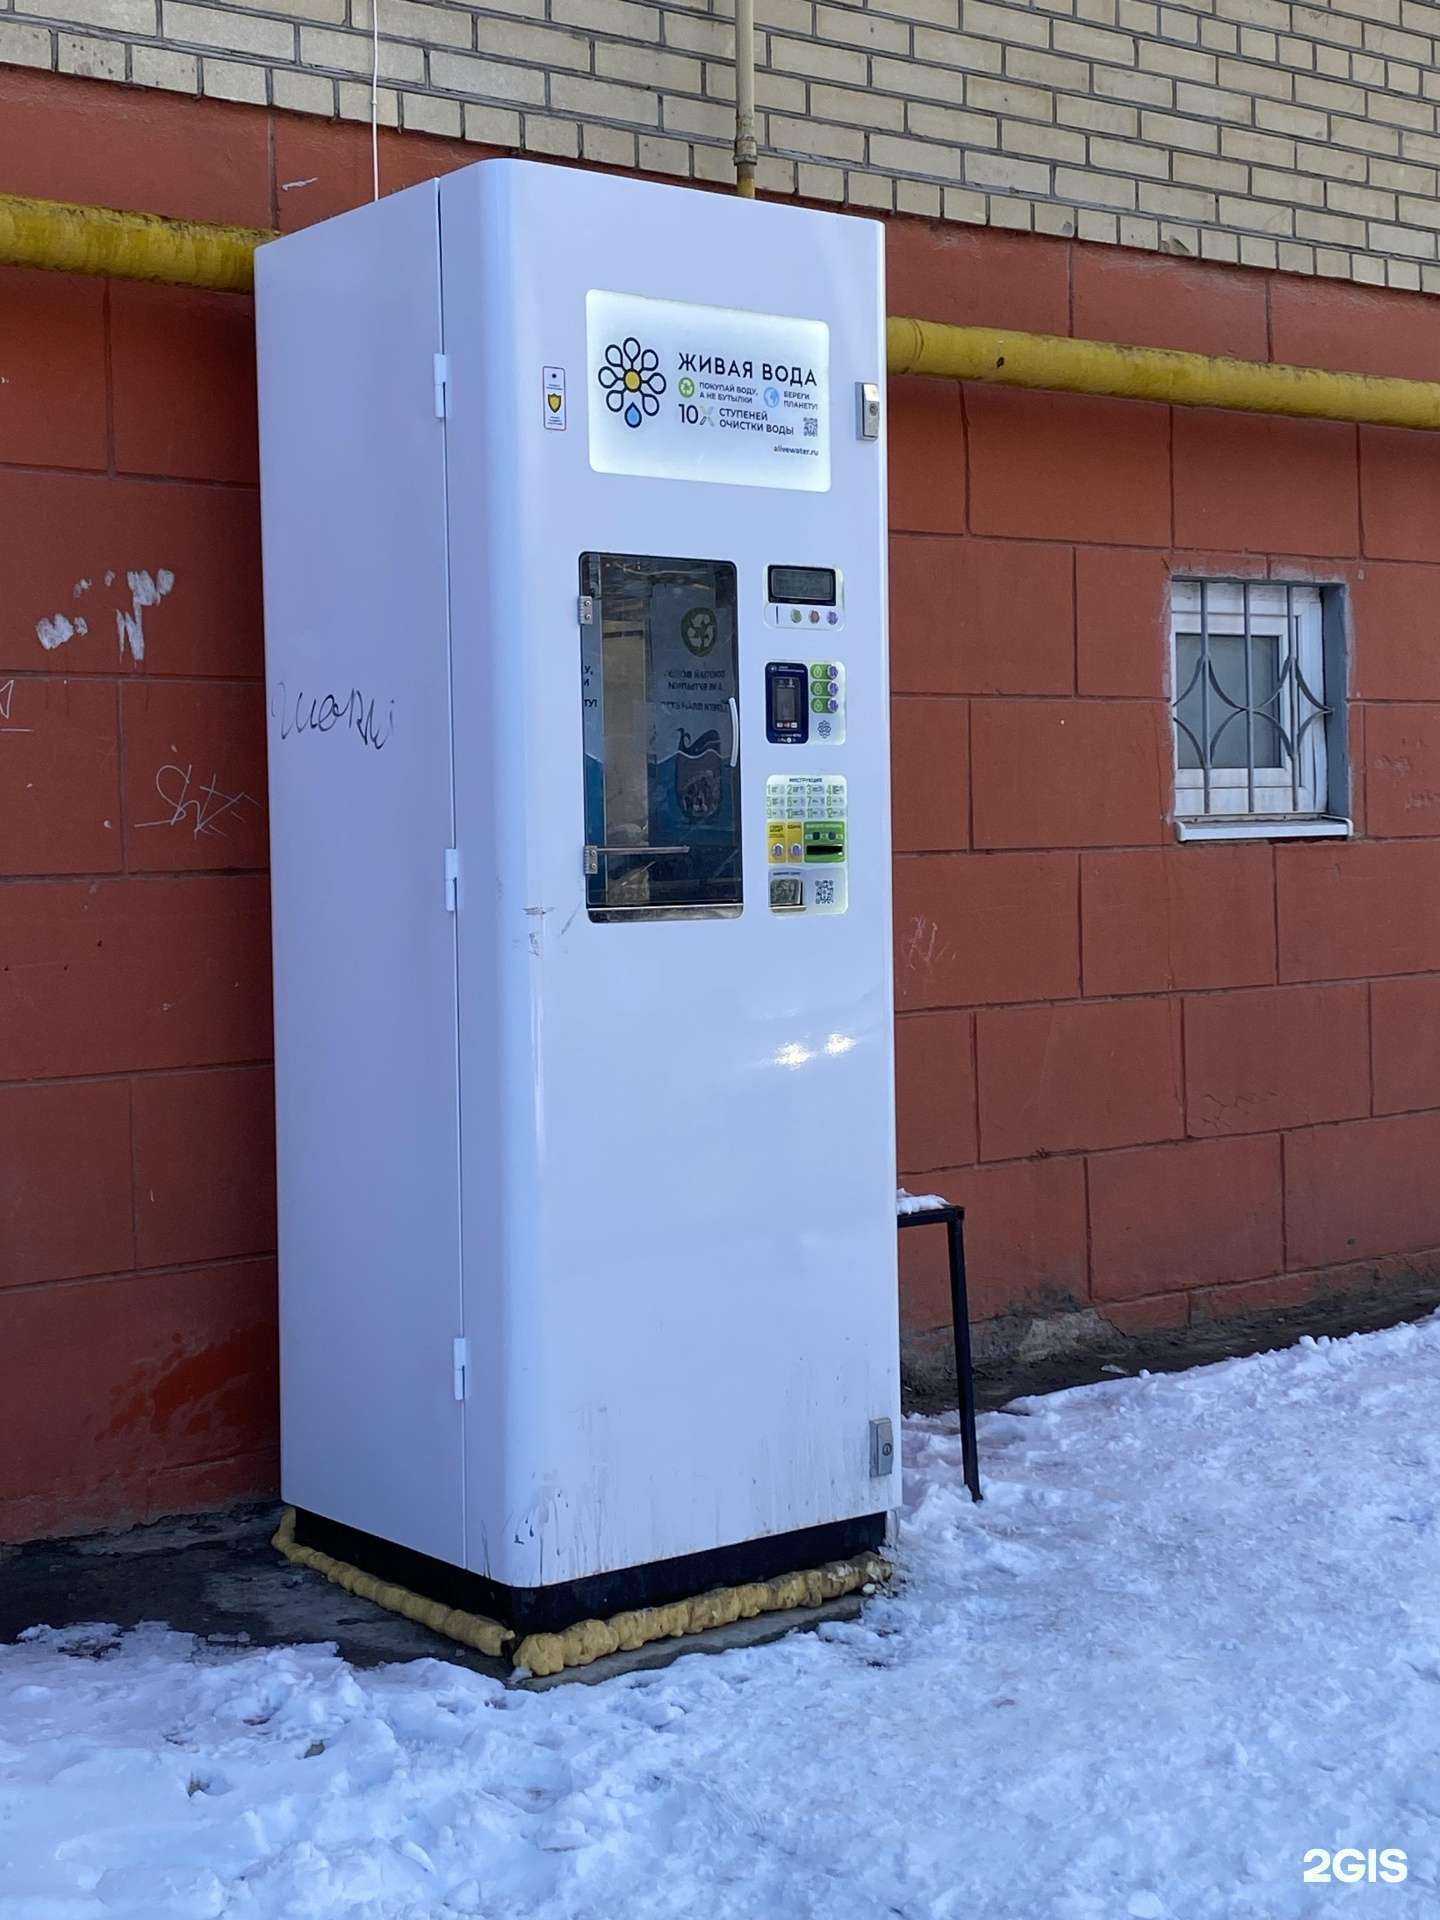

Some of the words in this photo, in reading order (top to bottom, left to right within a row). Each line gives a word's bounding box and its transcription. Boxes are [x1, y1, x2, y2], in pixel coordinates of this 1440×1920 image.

[678, 352, 753, 379] ЖИВАЯ
[762, 363, 817, 387] ВОДА
[699, 382, 735, 393] ПОКУПАЙ
[736, 386, 759, 397] ВОДУ,
[783, 391, 809, 400] БЕРЕГИ
[706, 393, 717, 401] НЕ
[718, 393, 753, 404] БУТЫЛКИ
[719, 408, 768, 422] СТУПЕНЕЙ
[719, 418, 764, 432] ОЧИСТКИ
[766, 423, 794, 436] ВОДЫ
[773, 444, 819, 457] alivewater.ru
